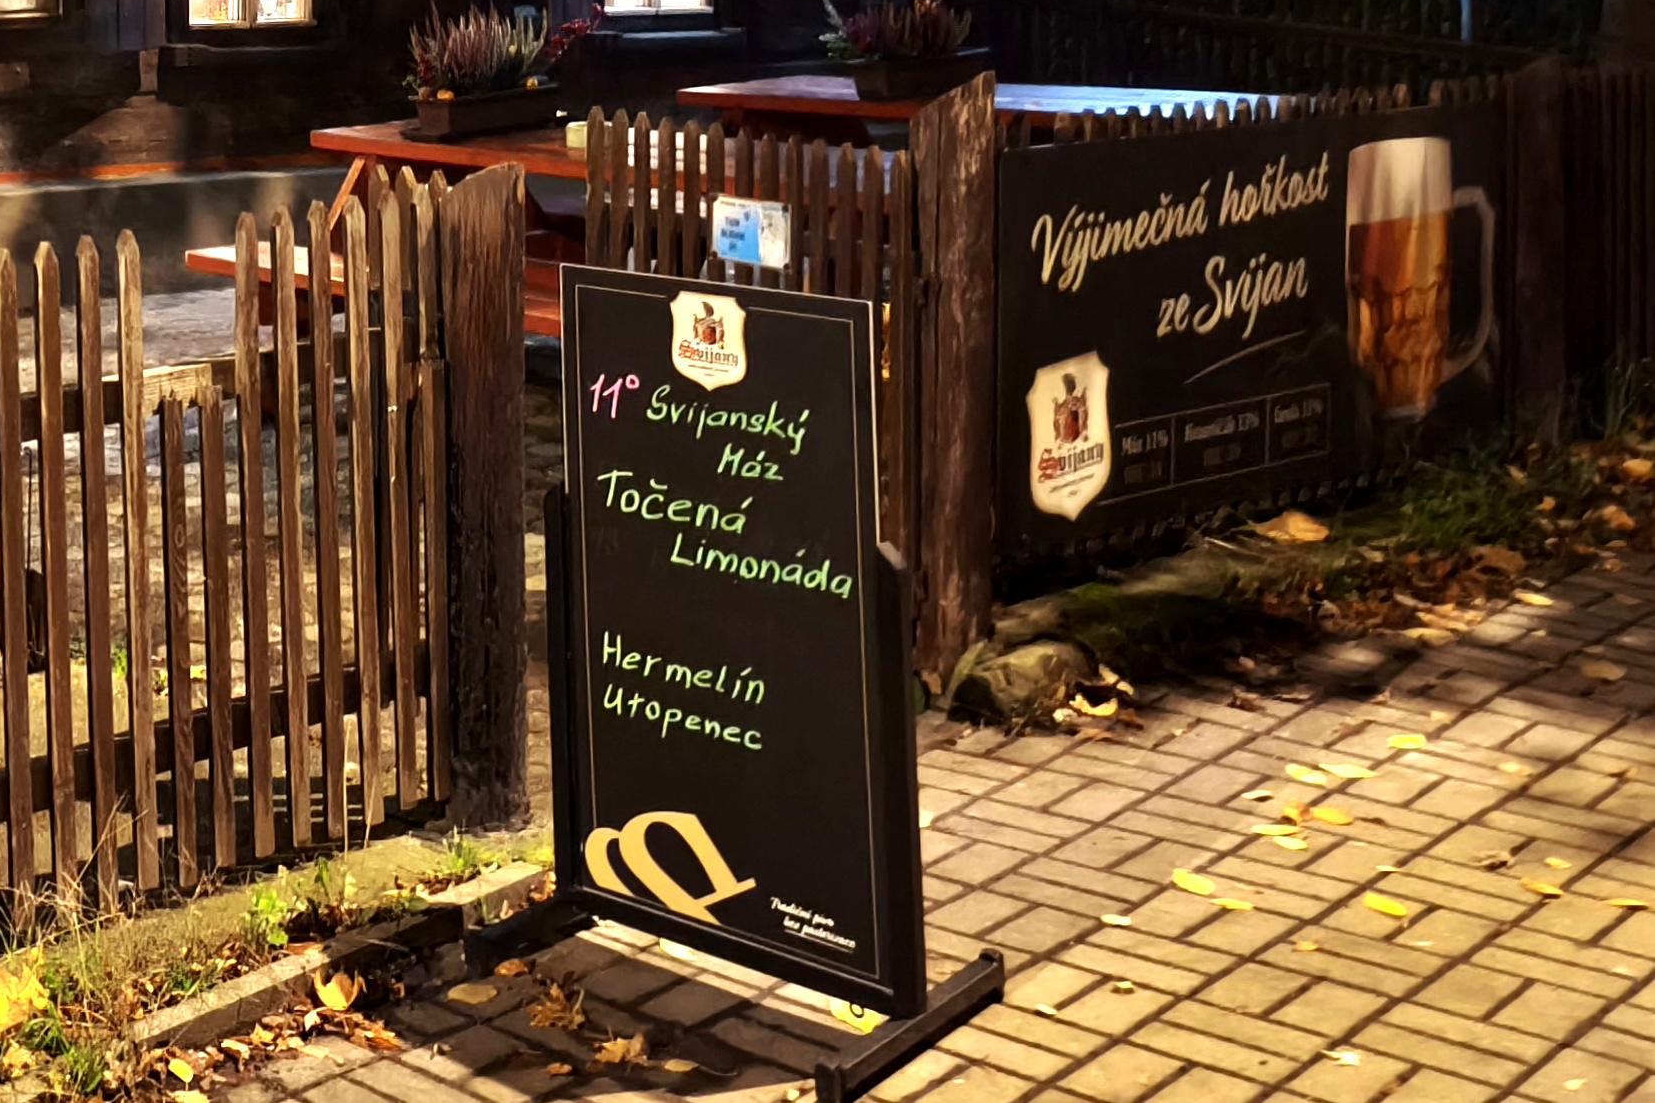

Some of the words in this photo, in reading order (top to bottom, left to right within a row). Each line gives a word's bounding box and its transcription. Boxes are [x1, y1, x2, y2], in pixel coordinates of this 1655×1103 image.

[1031, 178, 1212, 293] Výjimečná
[1218, 149, 1330, 227] hořkost
[1157, 292, 1191, 338] ze
[1193, 252, 1309, 340] Svijan
[678, 339, 739, 367] Svijany
[646, 384, 810, 455] Svijanský
[717, 443, 784, 481] Máz
[1038, 443, 1105, 484] Svijany
[597, 469, 753, 534] Točená
[670, 532, 853, 599] Limonáda
[603, 630, 765, 704] Hermelín
[603, 683, 762, 750] Utopenec
